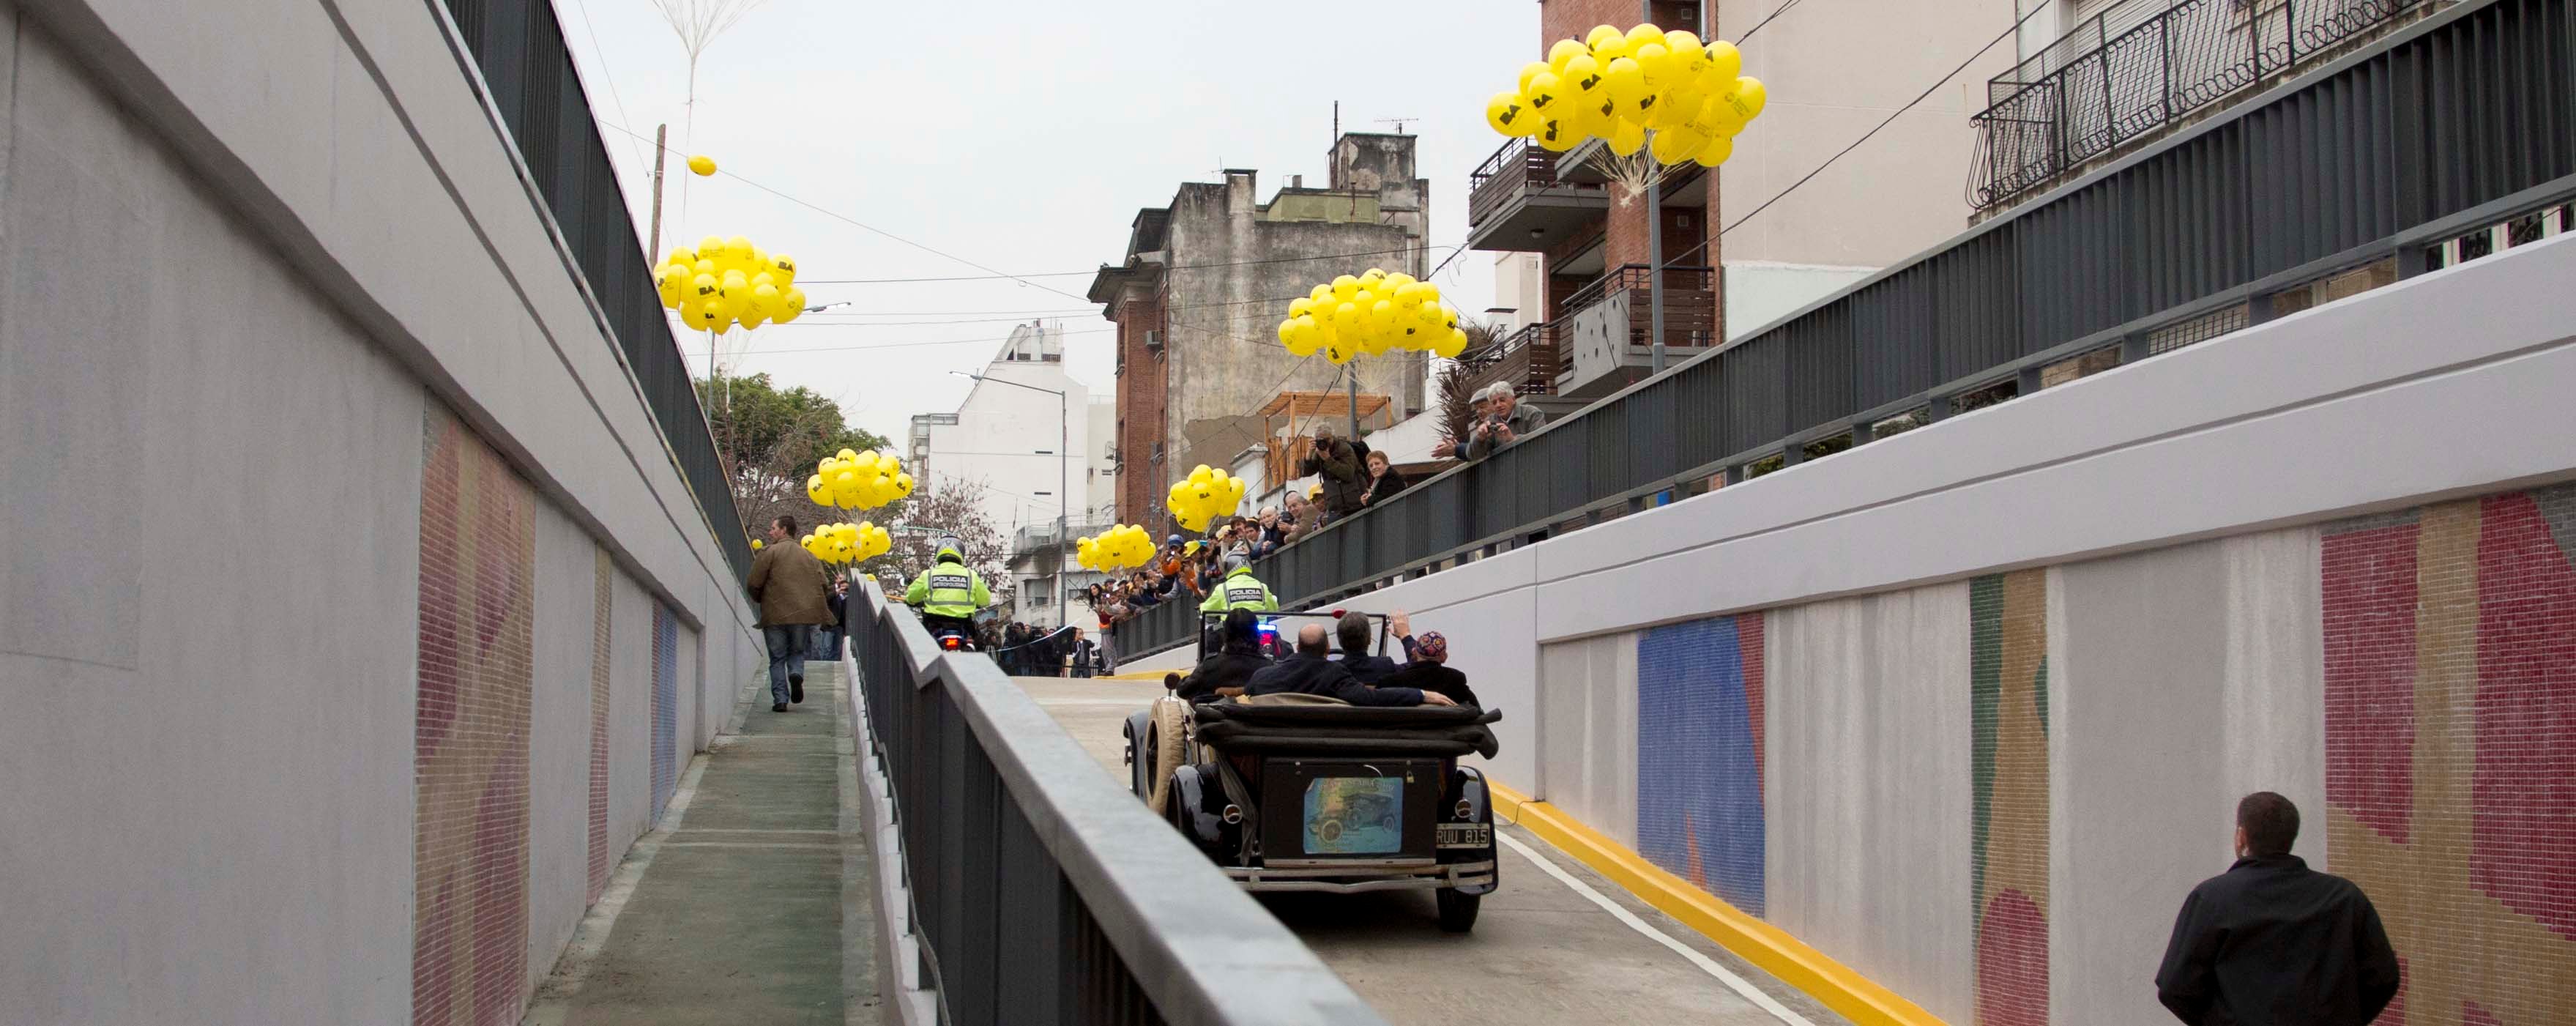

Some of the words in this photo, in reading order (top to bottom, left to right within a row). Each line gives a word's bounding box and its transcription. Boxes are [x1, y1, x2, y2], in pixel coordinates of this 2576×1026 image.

[1580, 73, 1602, 91] BA
[1533, 93, 1553, 108] BA
[1499, 104, 1522, 125] BA
[1545, 119, 1558, 141] BA
[778, 261, 794, 273] BA
[699, 285, 716, 296] BA
[813, 483, 824, 492] BA
[896, 481, 906, 491] BA
[1436, 830, 1458, 844] RUU
[1465, 829, 1487, 843] 815
